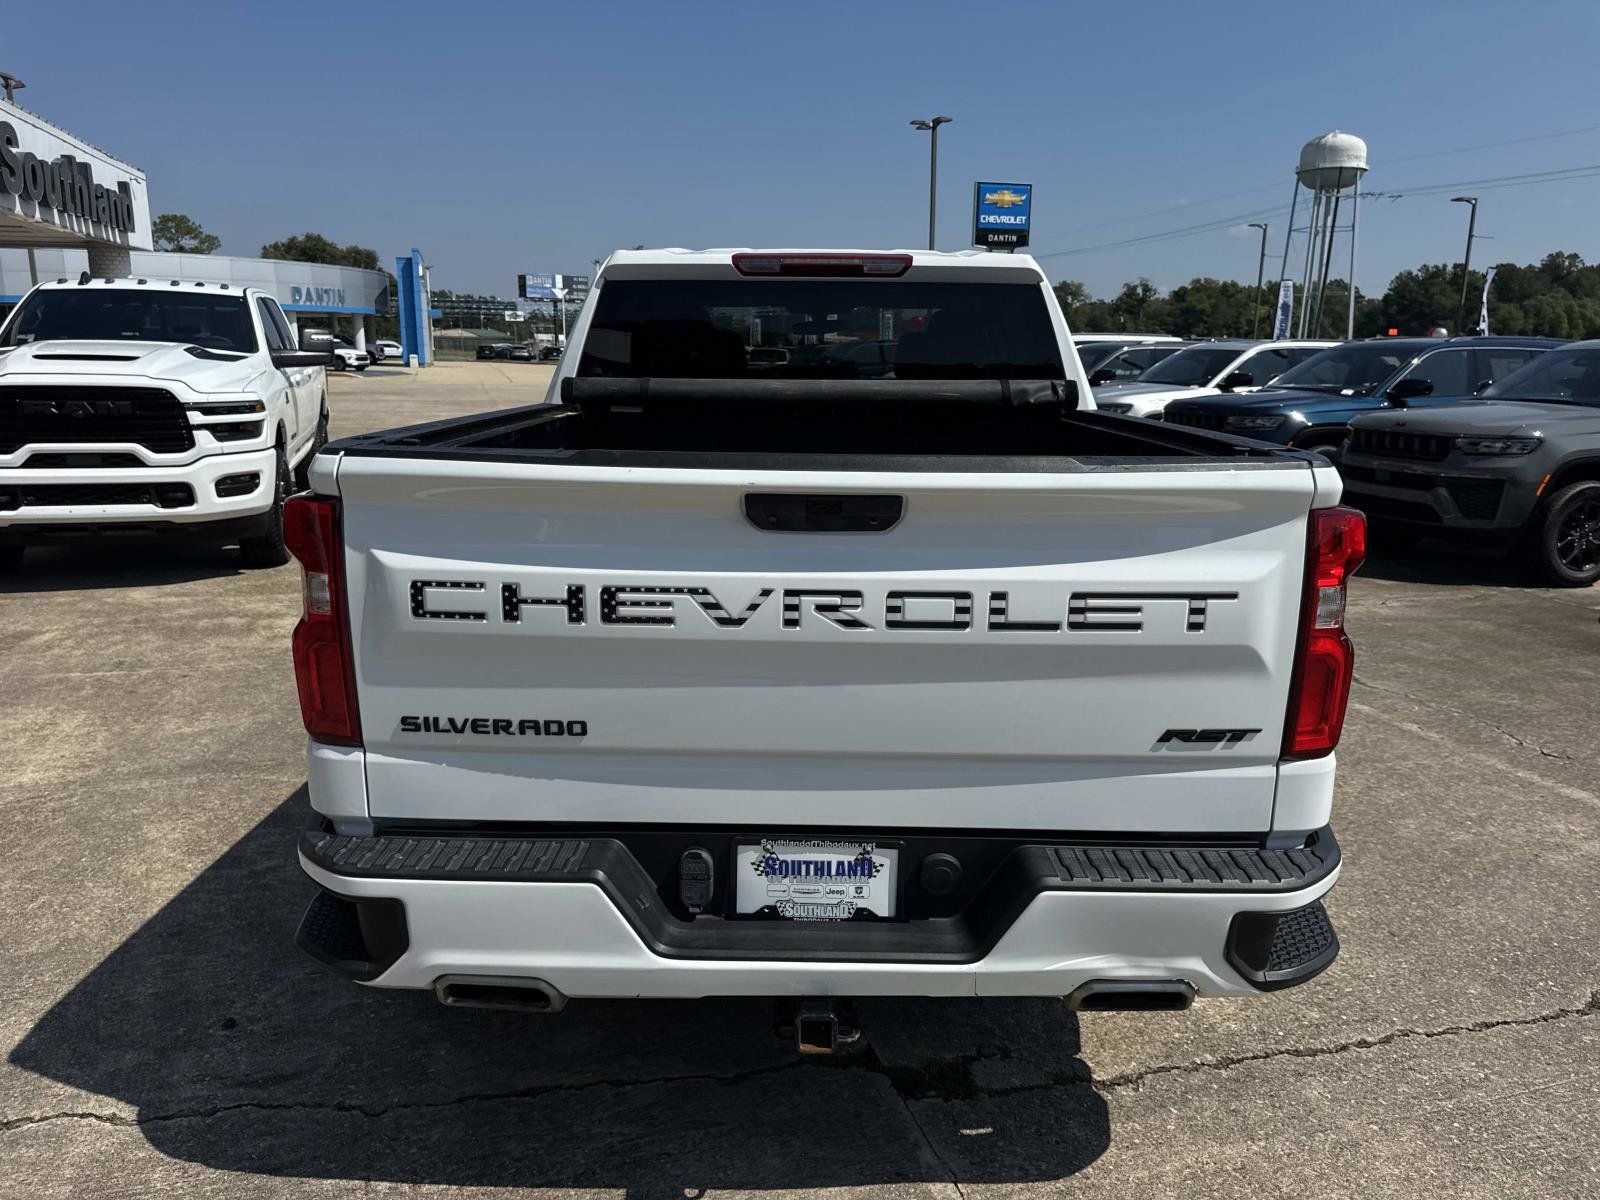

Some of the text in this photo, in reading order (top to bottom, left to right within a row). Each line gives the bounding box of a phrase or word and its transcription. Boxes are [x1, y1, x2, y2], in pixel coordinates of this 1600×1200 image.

[0, 121, 135, 233] Southland
[980, 215, 1027, 224] CHEVROLET
[988, 234, 1017, 242] DANTIN
[290, 286, 345, 307] DANTIN
[409, 580, 1239, 633] CHEVROLET
[400, 715, 588, 737] SILVERADO
[1156, 728, 1263, 743] RST
[826, 888, 845, 896] Jeep
[784, 902, 849, 918] SOUTHLAND
